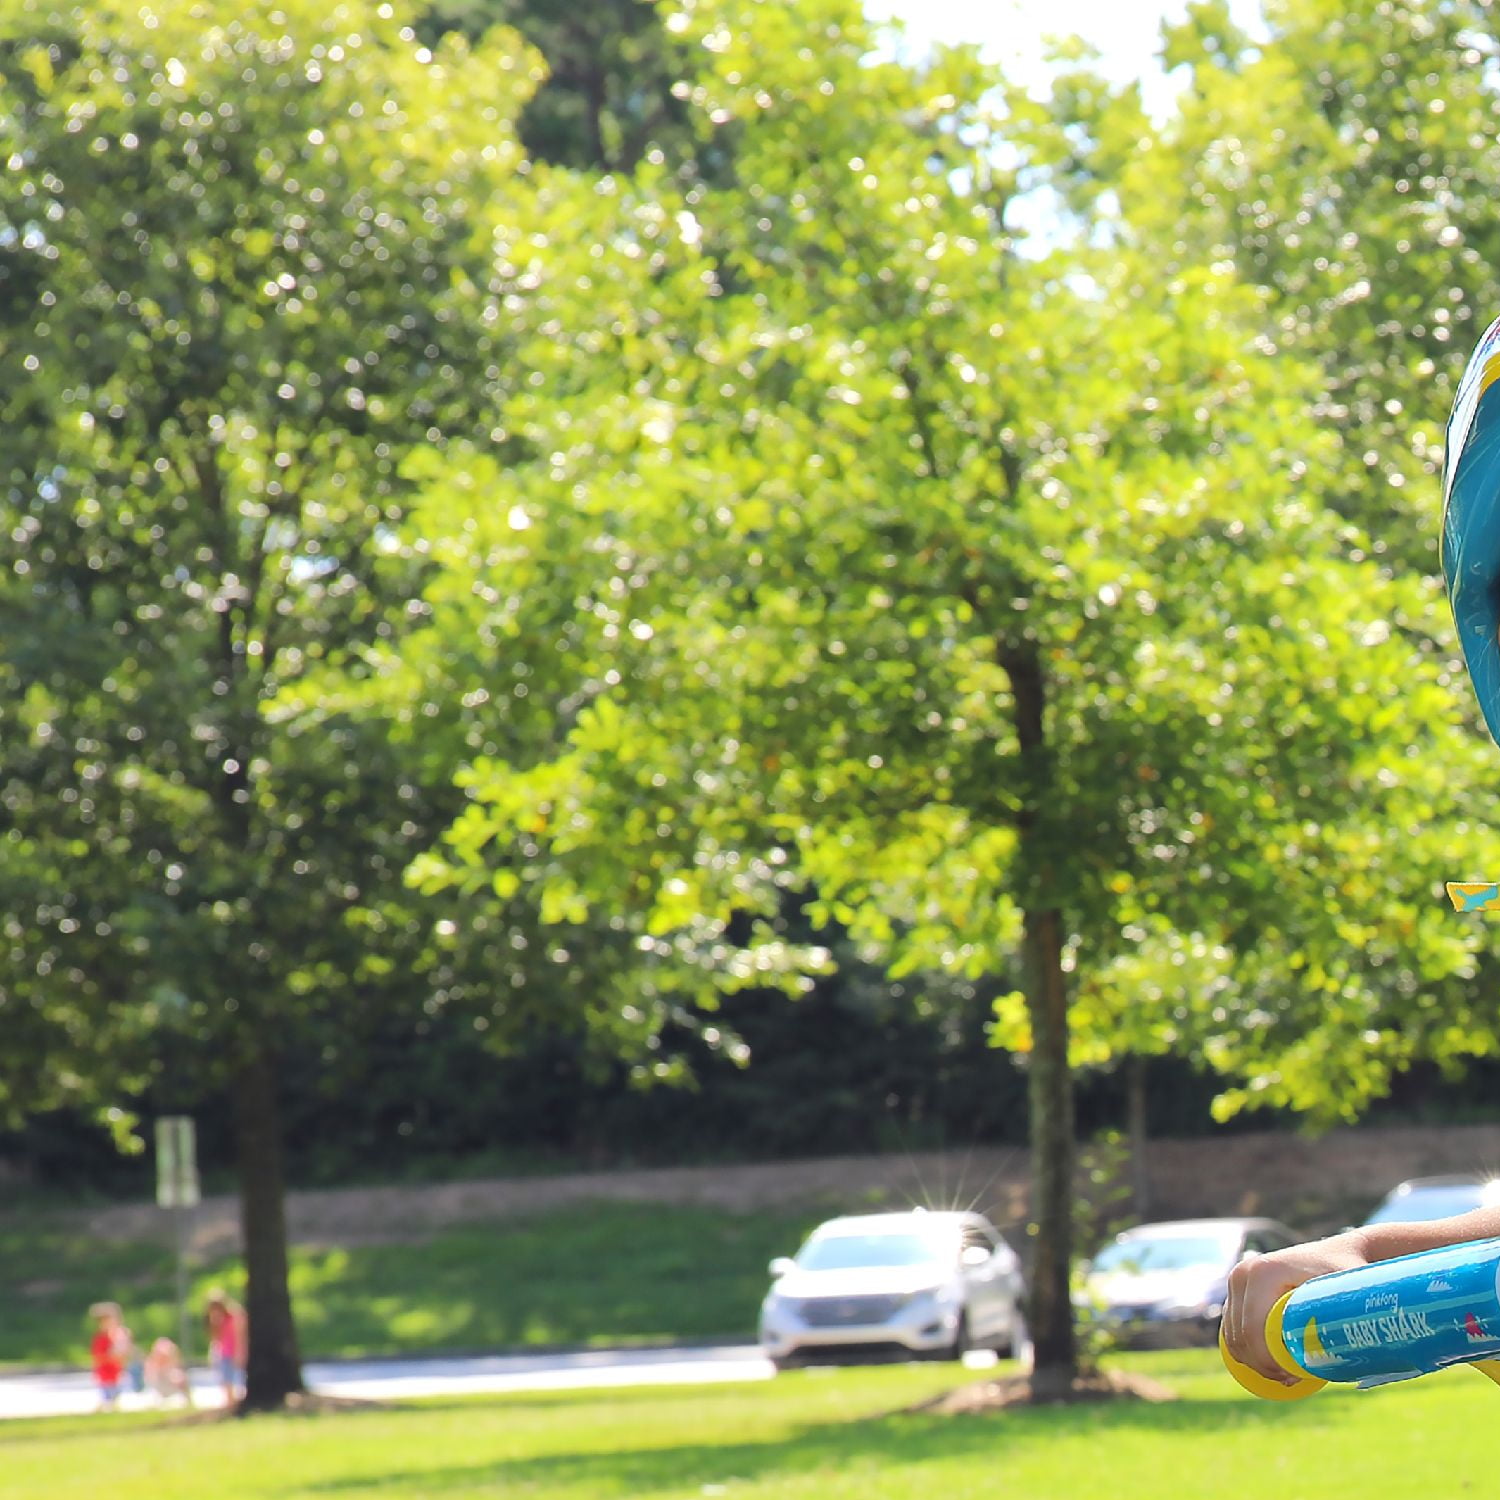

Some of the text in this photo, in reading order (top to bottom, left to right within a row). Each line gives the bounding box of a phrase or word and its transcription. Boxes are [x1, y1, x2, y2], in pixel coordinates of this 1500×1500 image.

[1365, 1293, 1399, 1313] pinkfong
[1342, 1307, 1436, 1348] BABY SHARK
